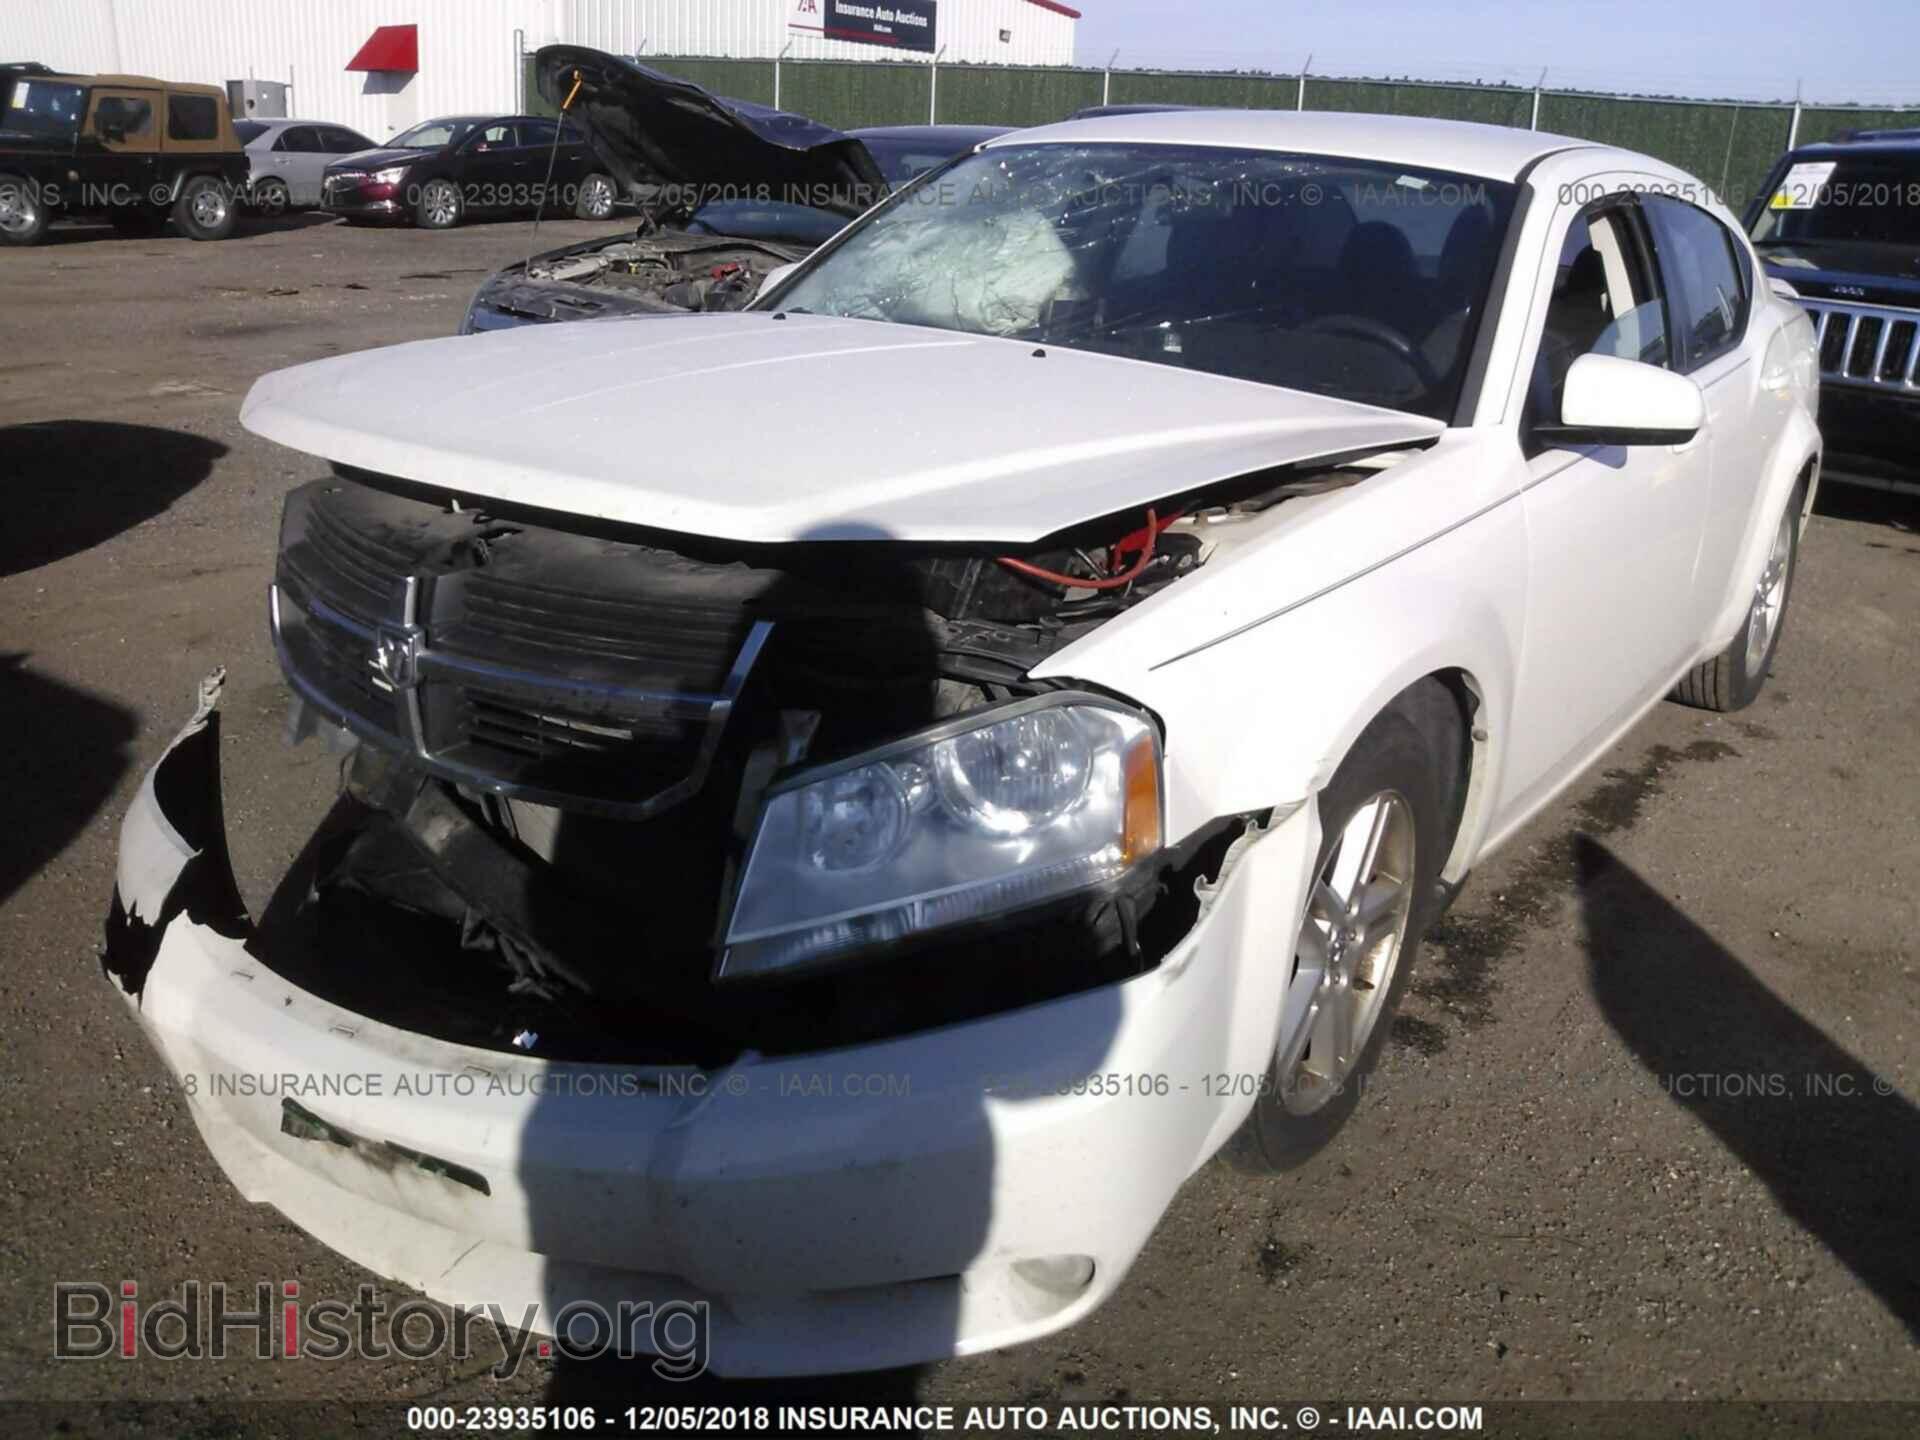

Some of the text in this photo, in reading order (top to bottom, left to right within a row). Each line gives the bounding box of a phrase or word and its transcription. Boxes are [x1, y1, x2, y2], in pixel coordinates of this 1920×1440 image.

[835, 1, 928, 28] Insurance Auto Auctions
